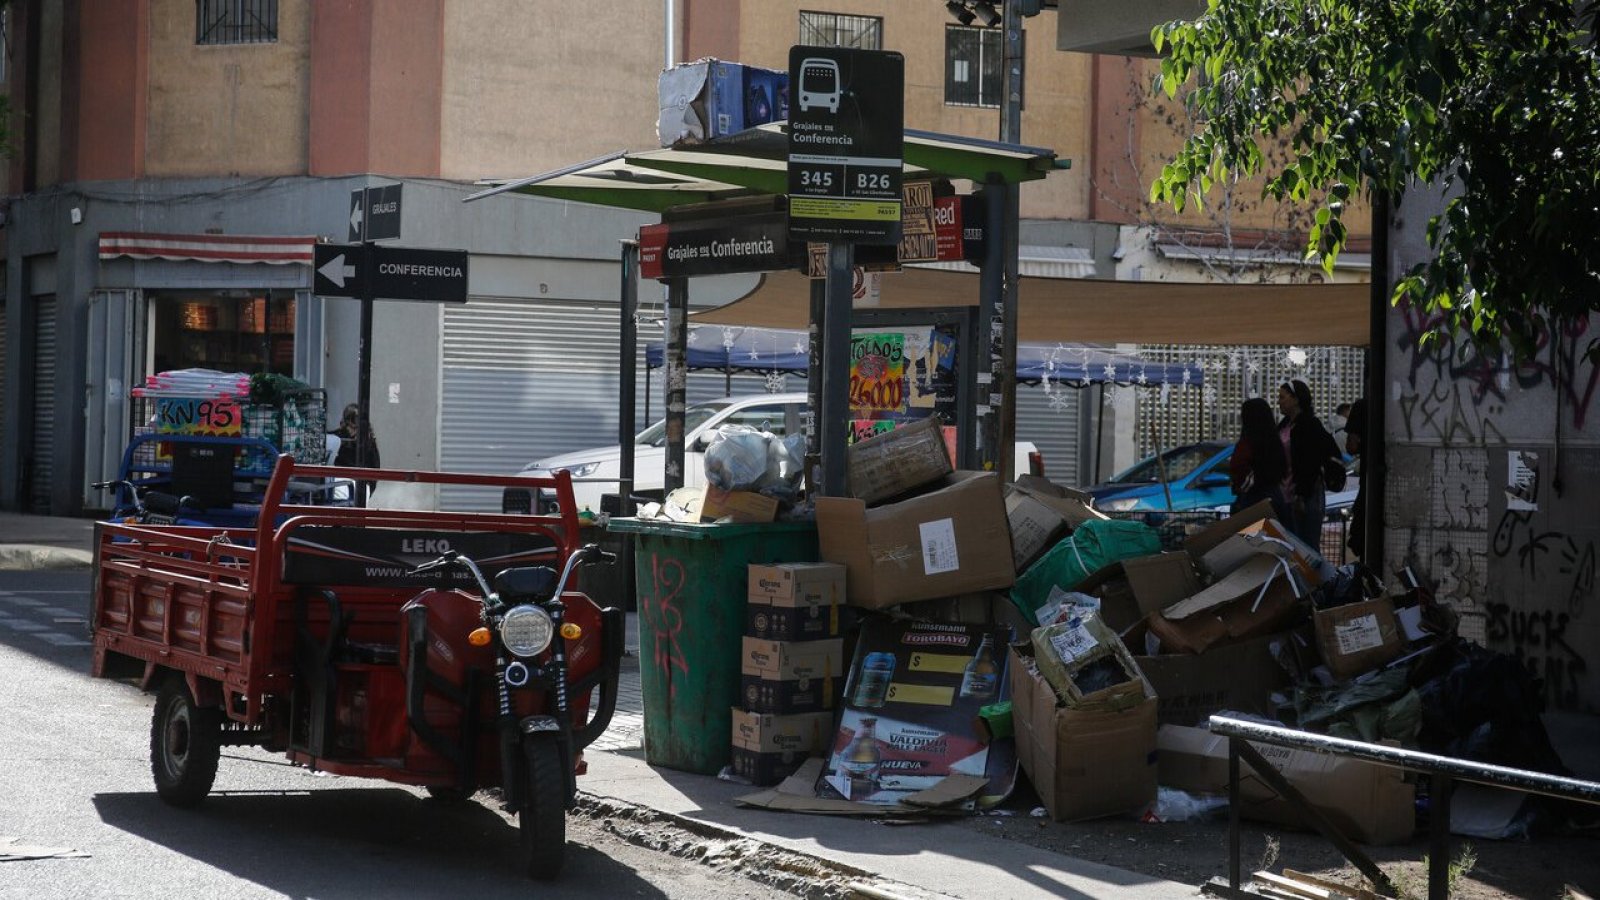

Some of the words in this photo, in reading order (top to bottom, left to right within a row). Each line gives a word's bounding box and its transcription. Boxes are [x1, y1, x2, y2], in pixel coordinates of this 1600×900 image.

[793, 122, 822, 131] Grajales
[793, 133, 853, 145] Conferencia
[801, 171, 832, 187] 345
[857, 173, 890, 189] B26
[372, 202, 397, 214] GRAJALES
[668, 244, 698, 262] Grajales
[711, 235, 775, 257] Conferencia
[379, 263, 463, 278] CONFERENCIA
[161, 402, 234, 427] KN95
[402, 538, 450, 553] LEKO
[906, 634, 966, 644] TOROBAYO
[889, 735, 947, 747] VALDIVIA
[881, 760, 921, 769] NUEVA
